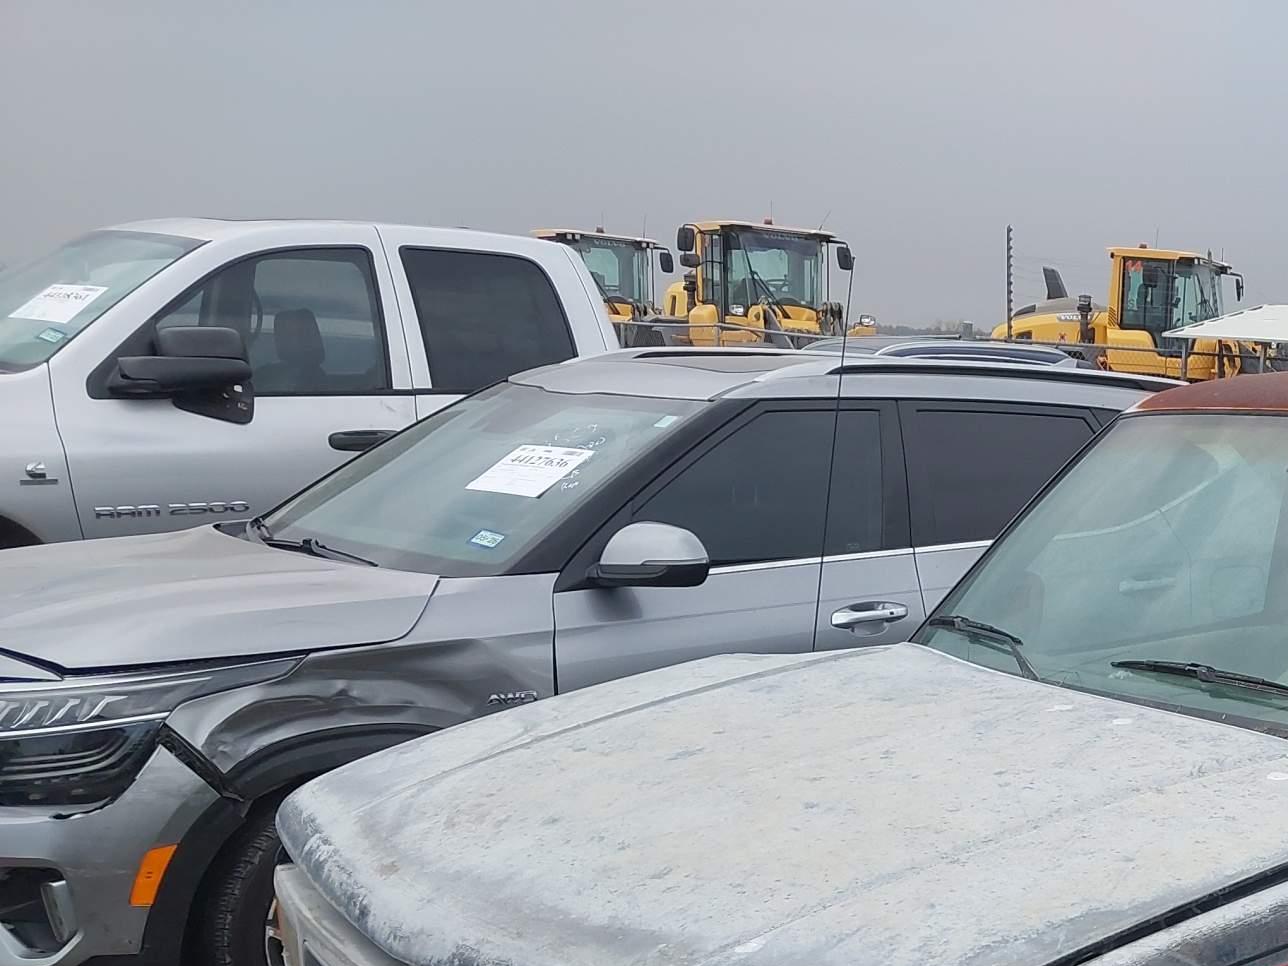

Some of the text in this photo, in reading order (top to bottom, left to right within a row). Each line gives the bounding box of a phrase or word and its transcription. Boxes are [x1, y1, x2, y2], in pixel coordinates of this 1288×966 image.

[94, 500, 250, 519] RAM 2500
[487, 690, 538, 705] AWD
